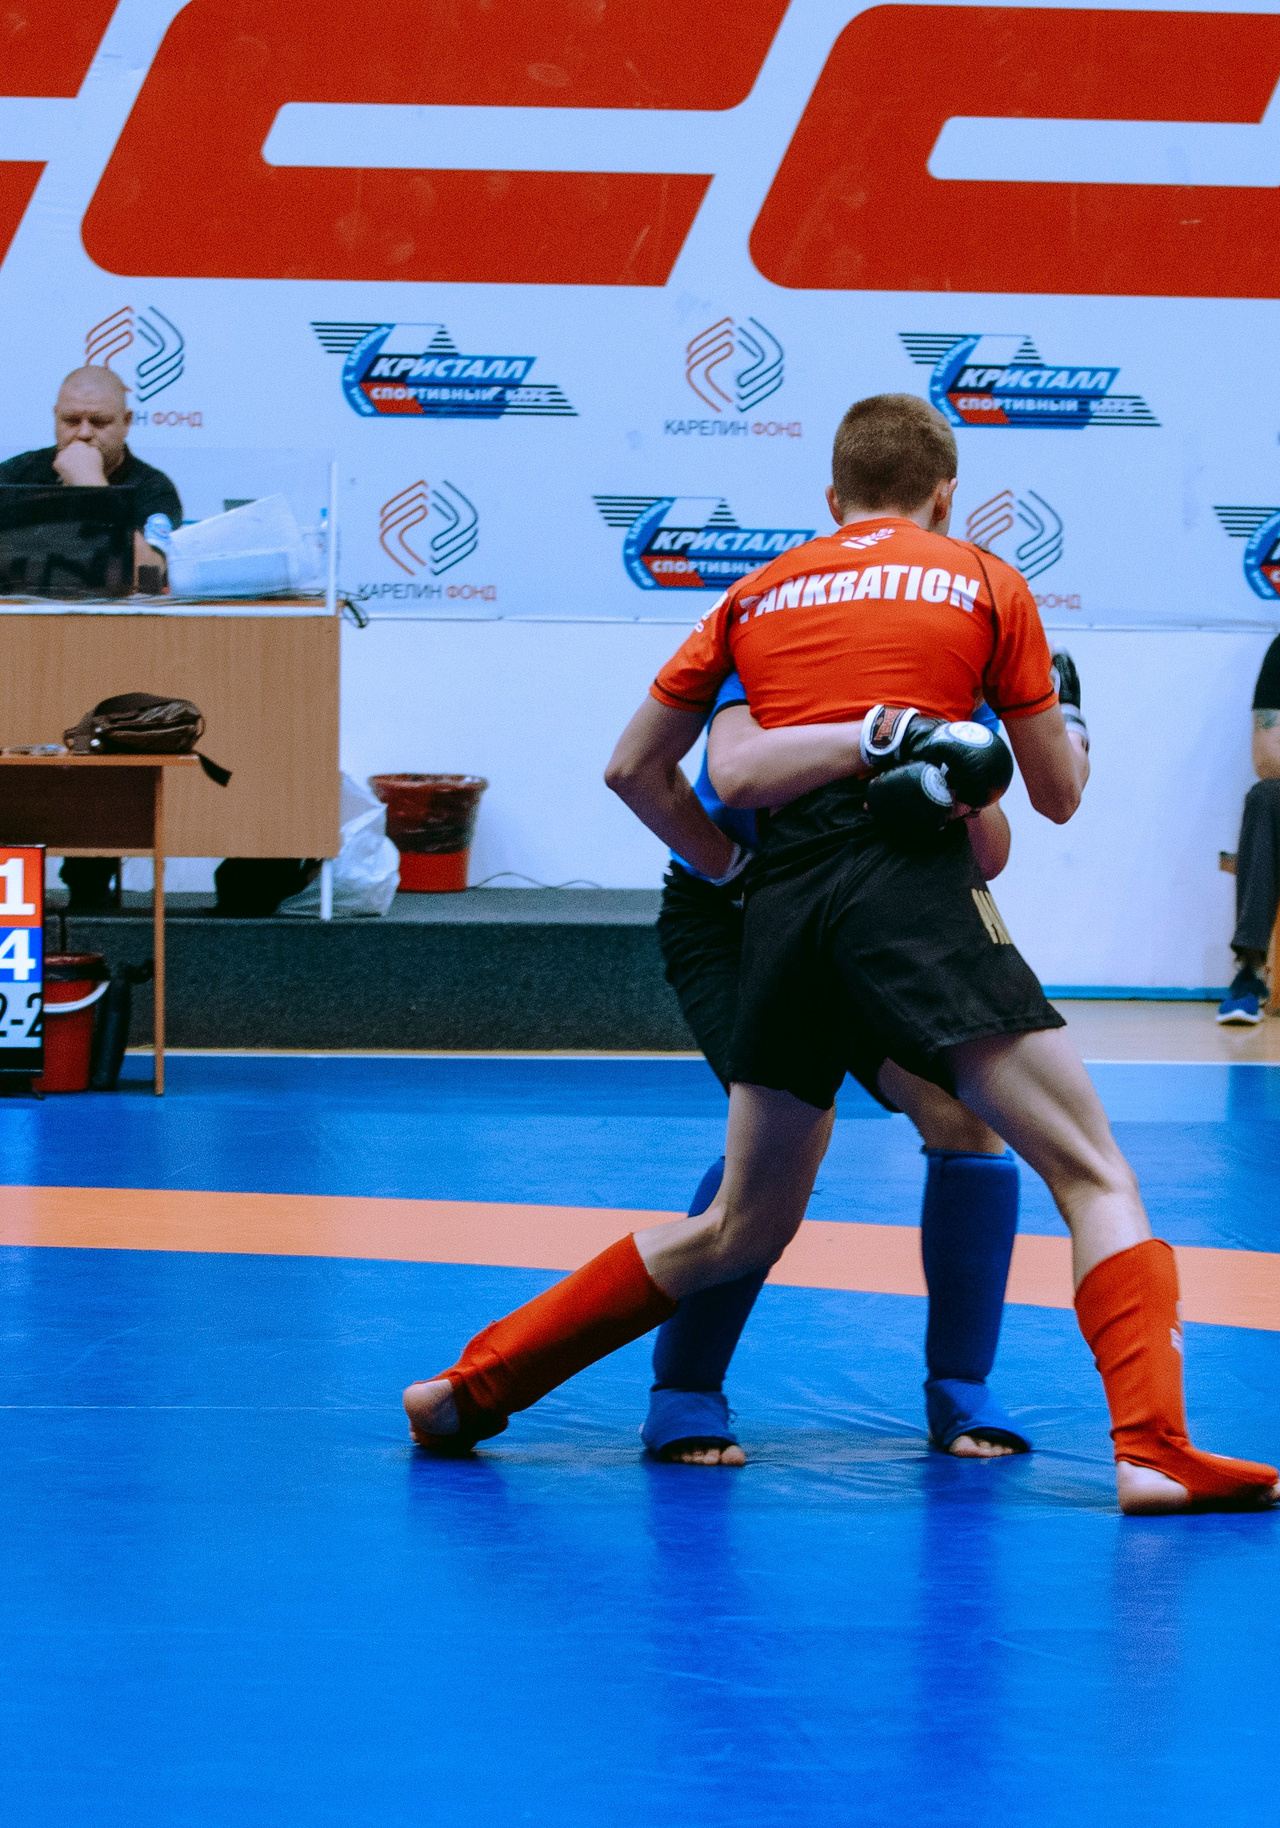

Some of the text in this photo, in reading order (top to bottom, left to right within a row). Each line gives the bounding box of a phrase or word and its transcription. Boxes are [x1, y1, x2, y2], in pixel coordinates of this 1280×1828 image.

[370, 356, 527, 379] КРИСТАЛЛ
[957, 367, 1112, 390] КРИСТАЛЛ
[370, 385, 498, 402] СПОРТИВНЫЙ
[957, 397, 1078, 412] СПОРТИВНЫЙ
[152, 411, 203, 429] ФОНД
[664, 419, 802, 438] КАРЕЛИН ФОНД
[652, 559, 766, 575] СПОРТИВНЫ
[358, 583, 497, 601] КАРЕЛИН ФОНД
